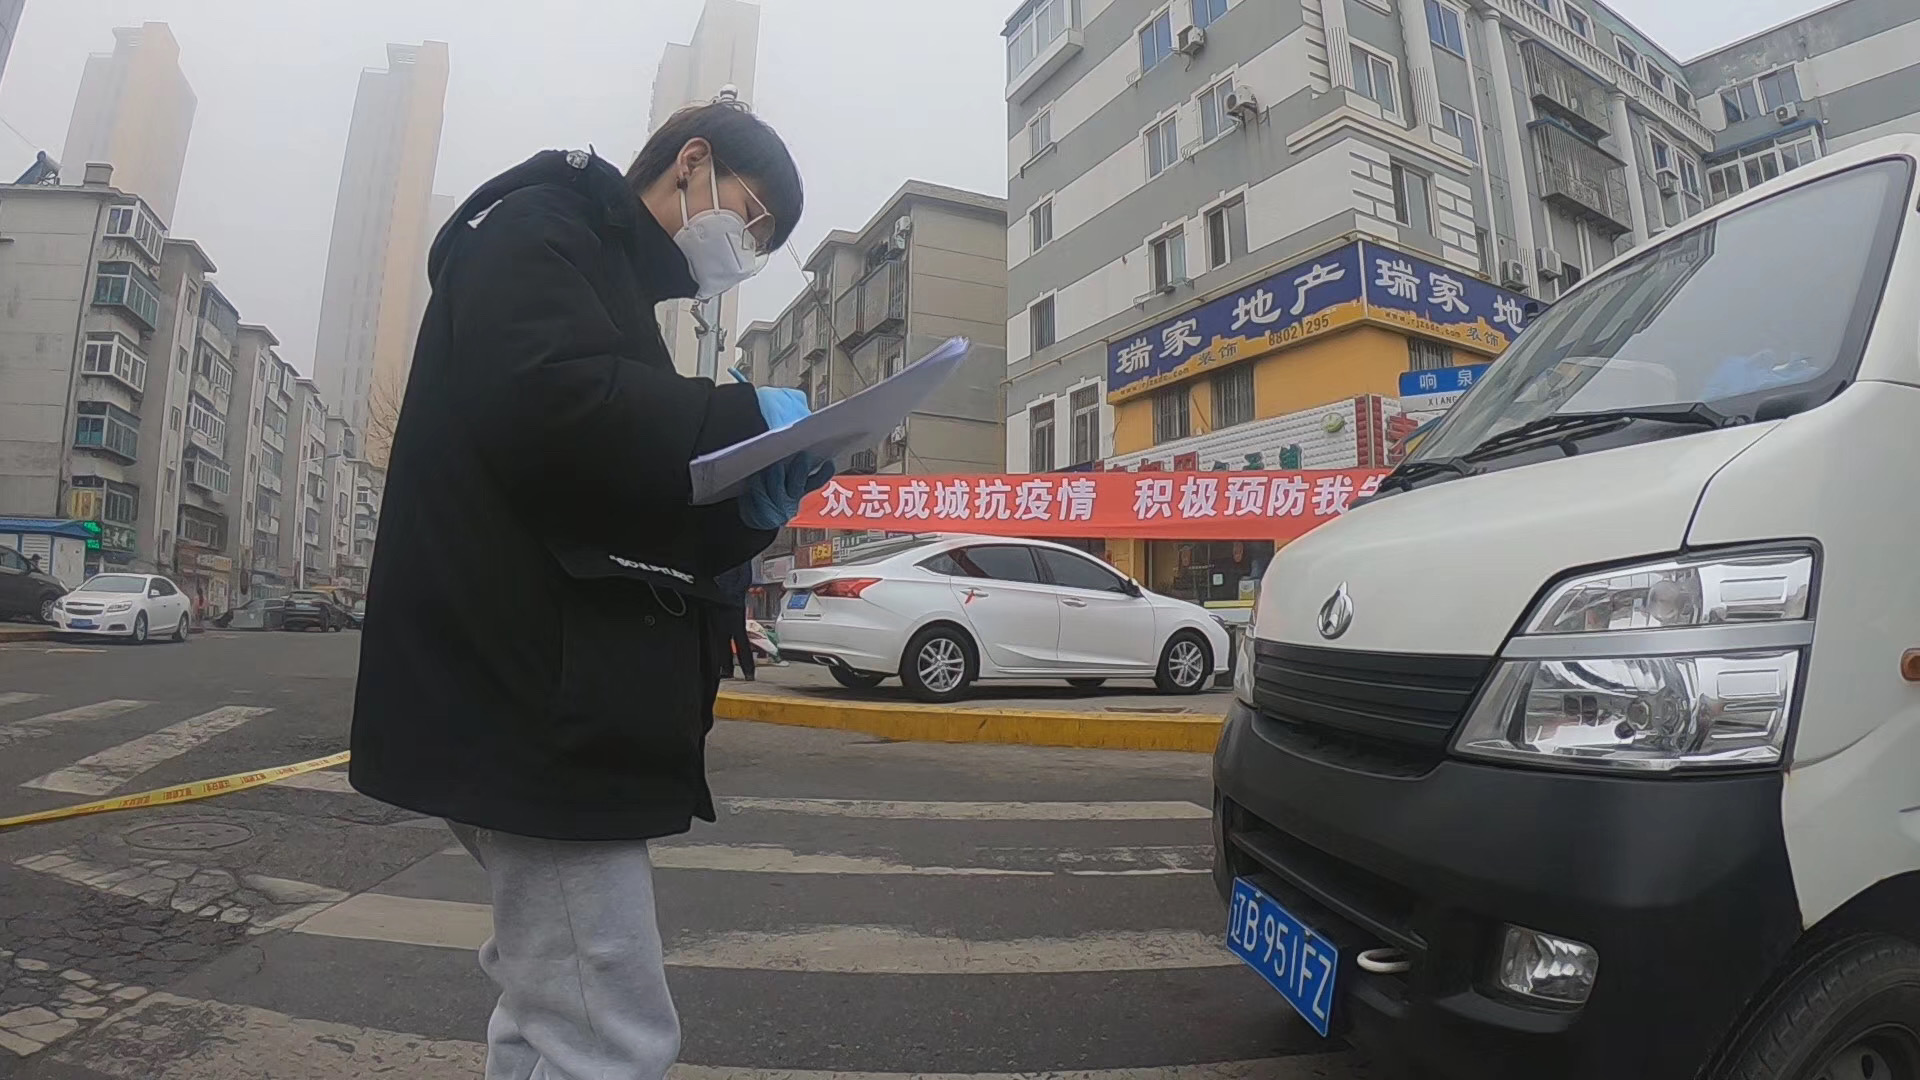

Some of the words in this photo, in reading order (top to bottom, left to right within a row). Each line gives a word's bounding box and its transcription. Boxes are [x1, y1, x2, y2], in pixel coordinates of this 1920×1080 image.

[1115, 261, 1346, 375] 瑞家地产
[1197, 342, 1237, 367] 装饰
[1268, 314, 1329, 347] 88021295
[1467, 327, 1499, 347] 装饰
[1419, 369, 1473, 390] 响泉
[818, 477, 1097, 522] 众志成城抗疫情
